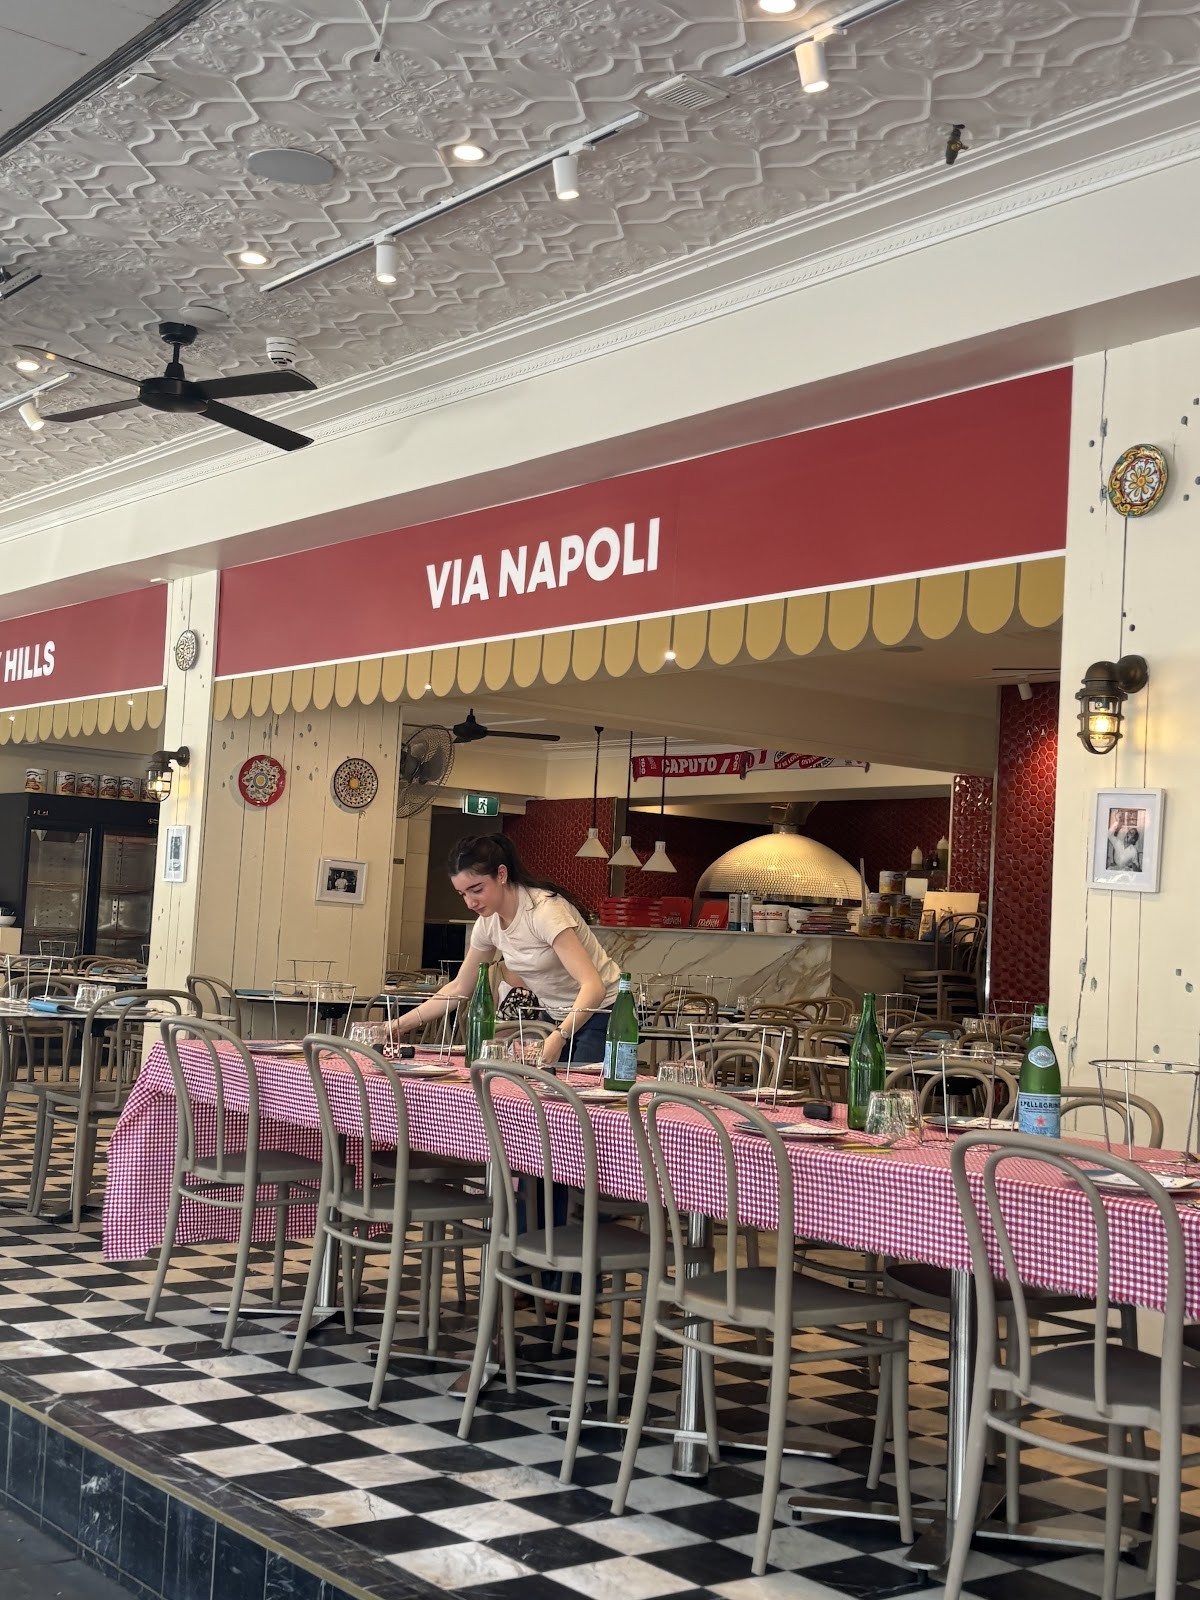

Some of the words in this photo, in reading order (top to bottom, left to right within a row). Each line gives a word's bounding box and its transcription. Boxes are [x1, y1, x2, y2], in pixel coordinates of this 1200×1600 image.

[426, 554, 490, 610] VIA
[498, 517, 661, 598] NAPOLI
[4, 640, 56, 683] HILLS
[661, 757, 718, 774] CAPUTO
